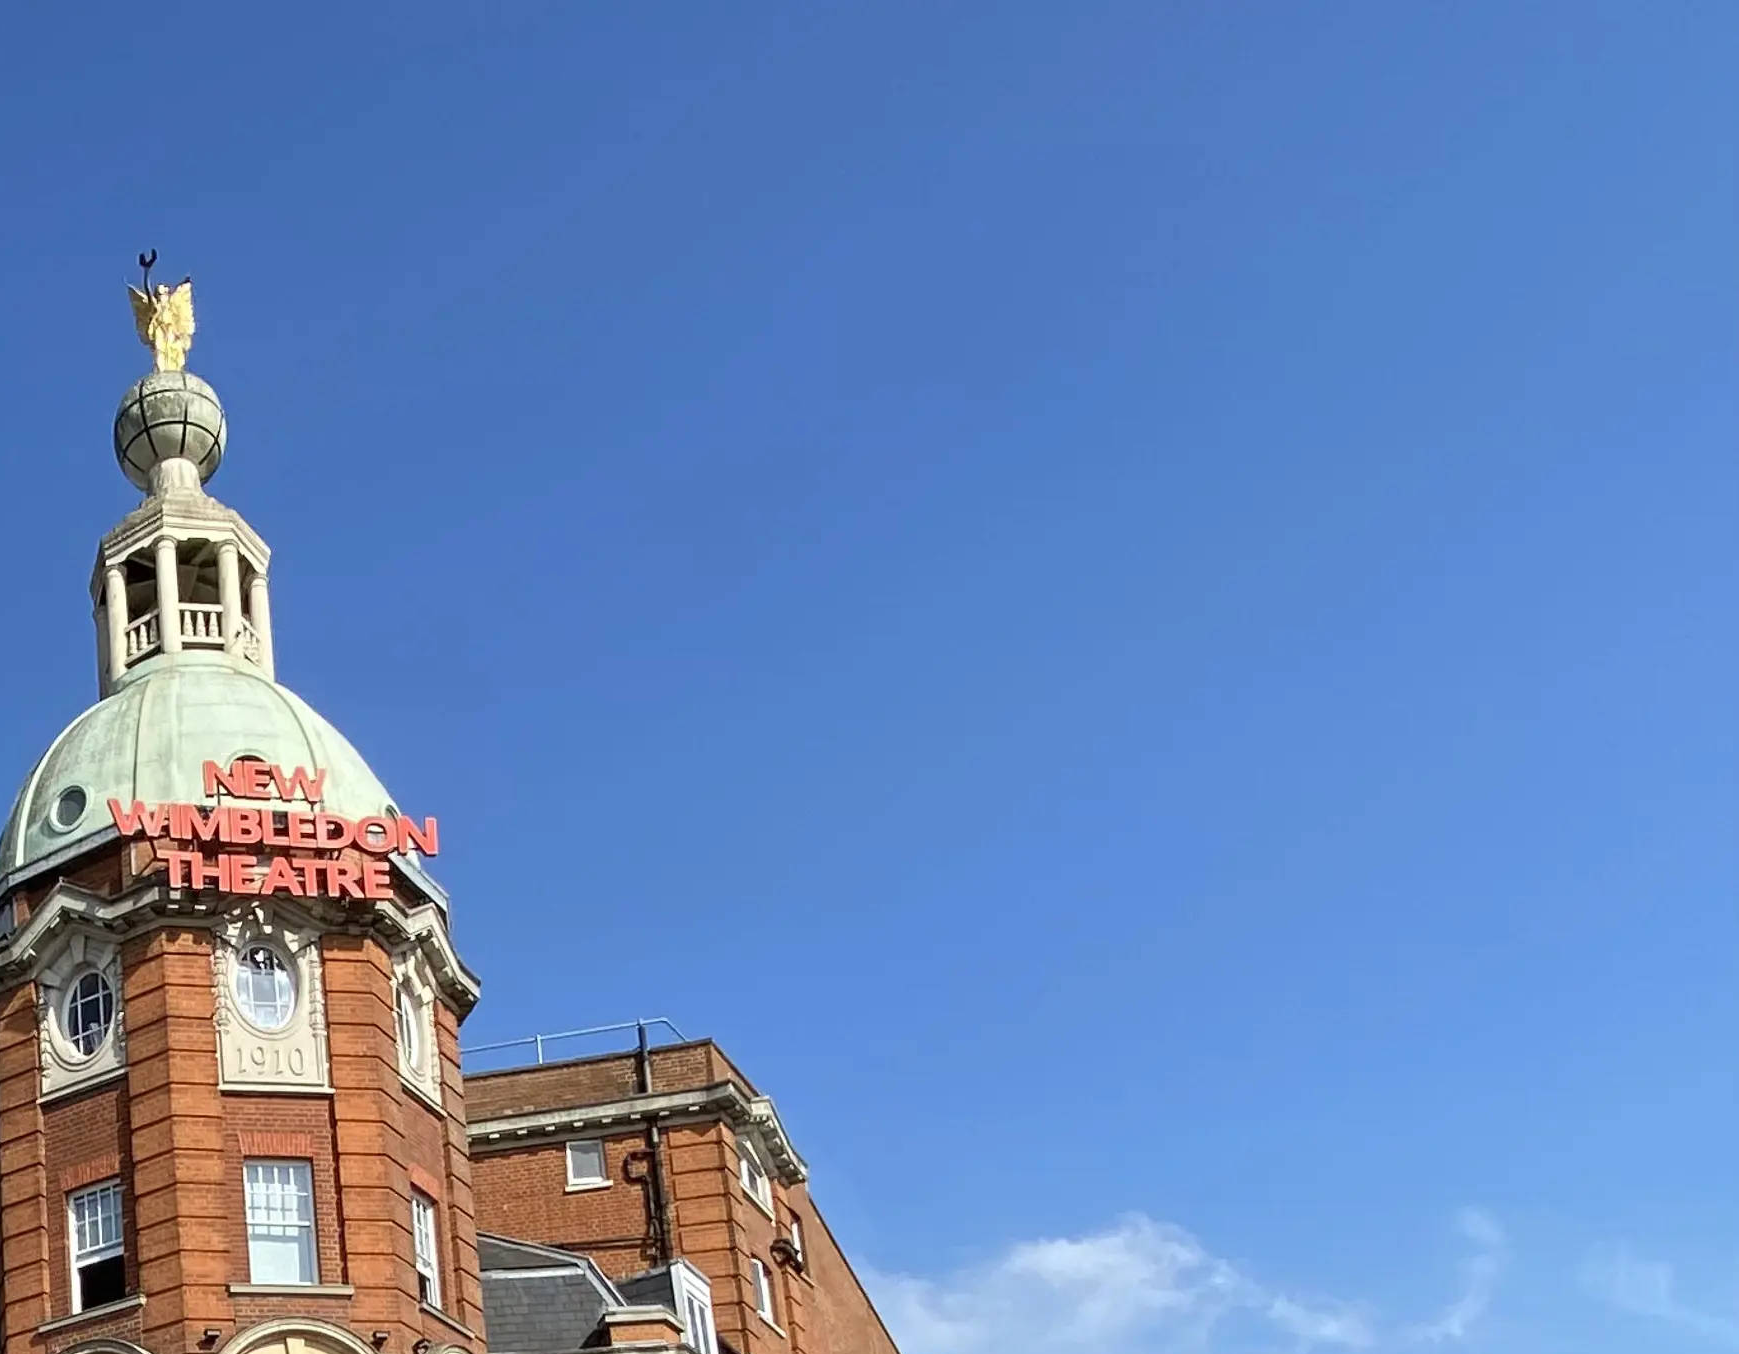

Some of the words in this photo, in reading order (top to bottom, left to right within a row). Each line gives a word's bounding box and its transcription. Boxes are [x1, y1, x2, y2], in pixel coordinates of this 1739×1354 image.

[202, 759, 327, 802] NEW
[107, 797, 438, 856] WIMBLEDON
[157, 849, 395, 899] THEATRE
[237, 1046, 305, 1077] 1910
